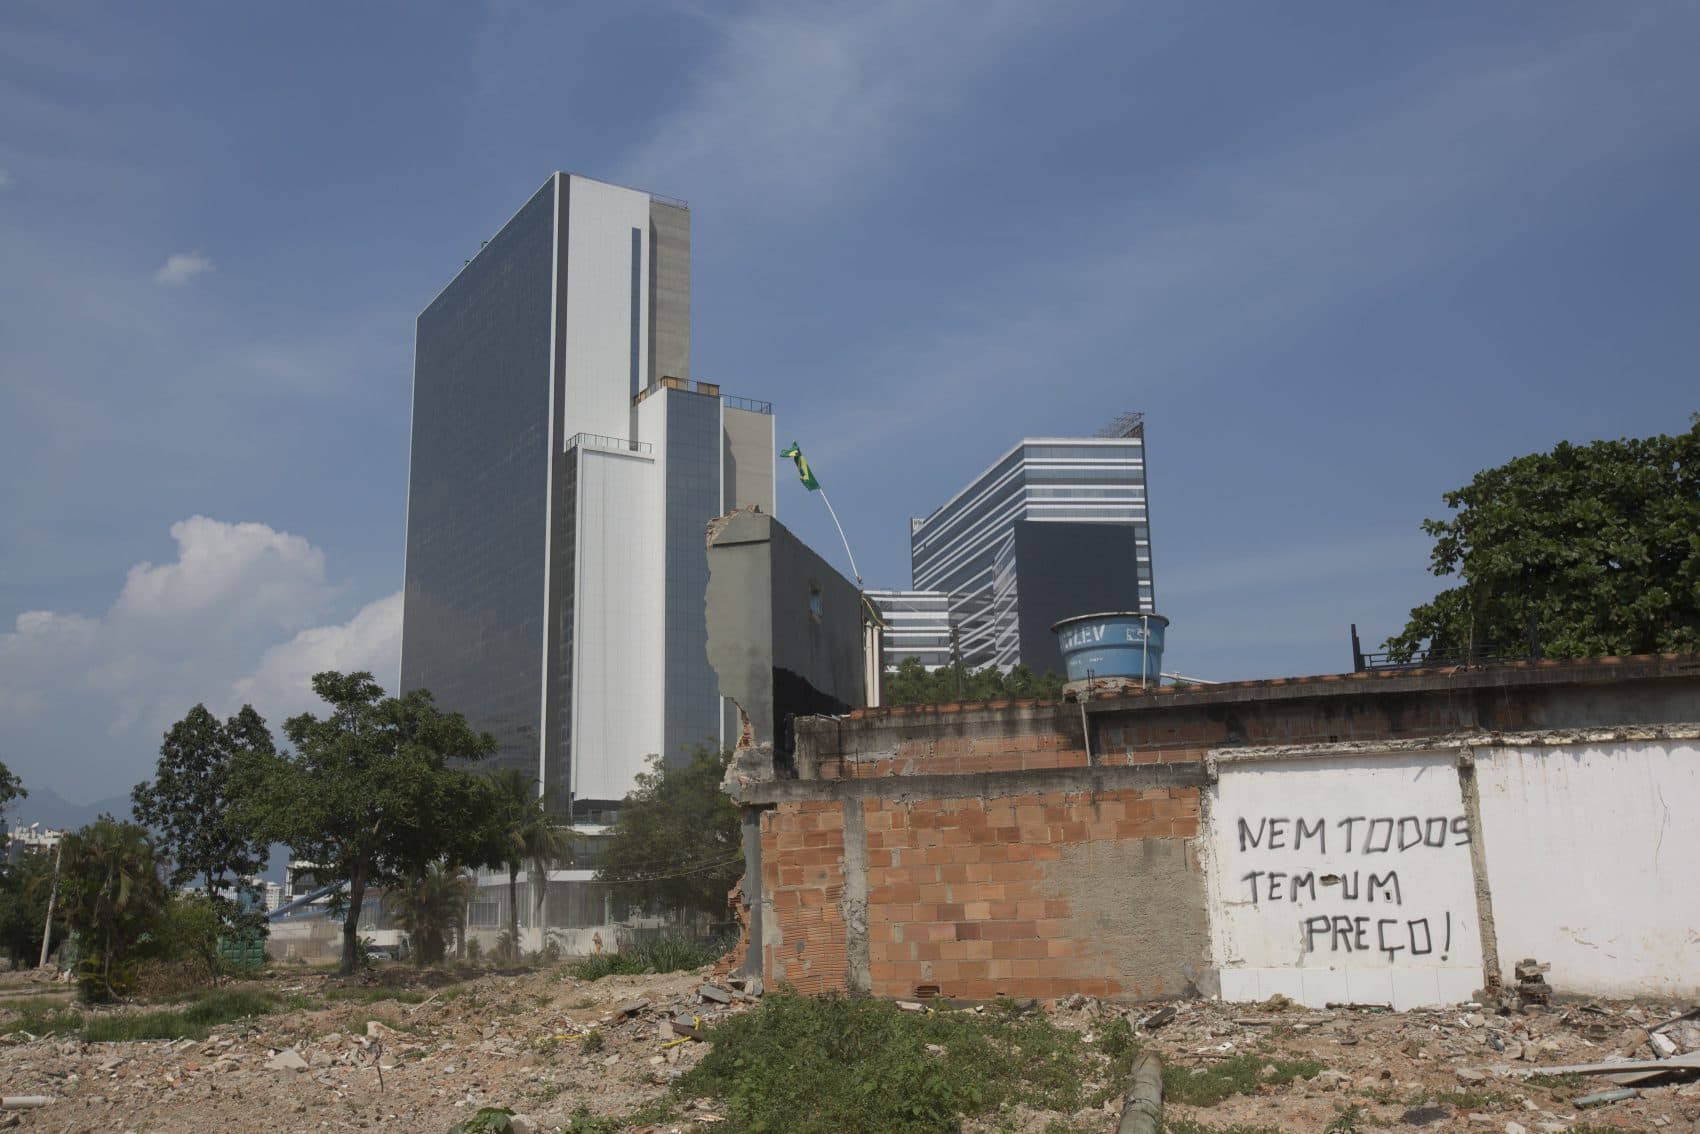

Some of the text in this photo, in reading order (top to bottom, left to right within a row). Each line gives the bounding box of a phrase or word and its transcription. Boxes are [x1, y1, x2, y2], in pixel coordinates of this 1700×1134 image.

[1237, 816, 1473, 855] NEM TODOS
[1241, 869, 1402, 905] TEM UM
[1305, 911, 1451, 964] PREÇO!
